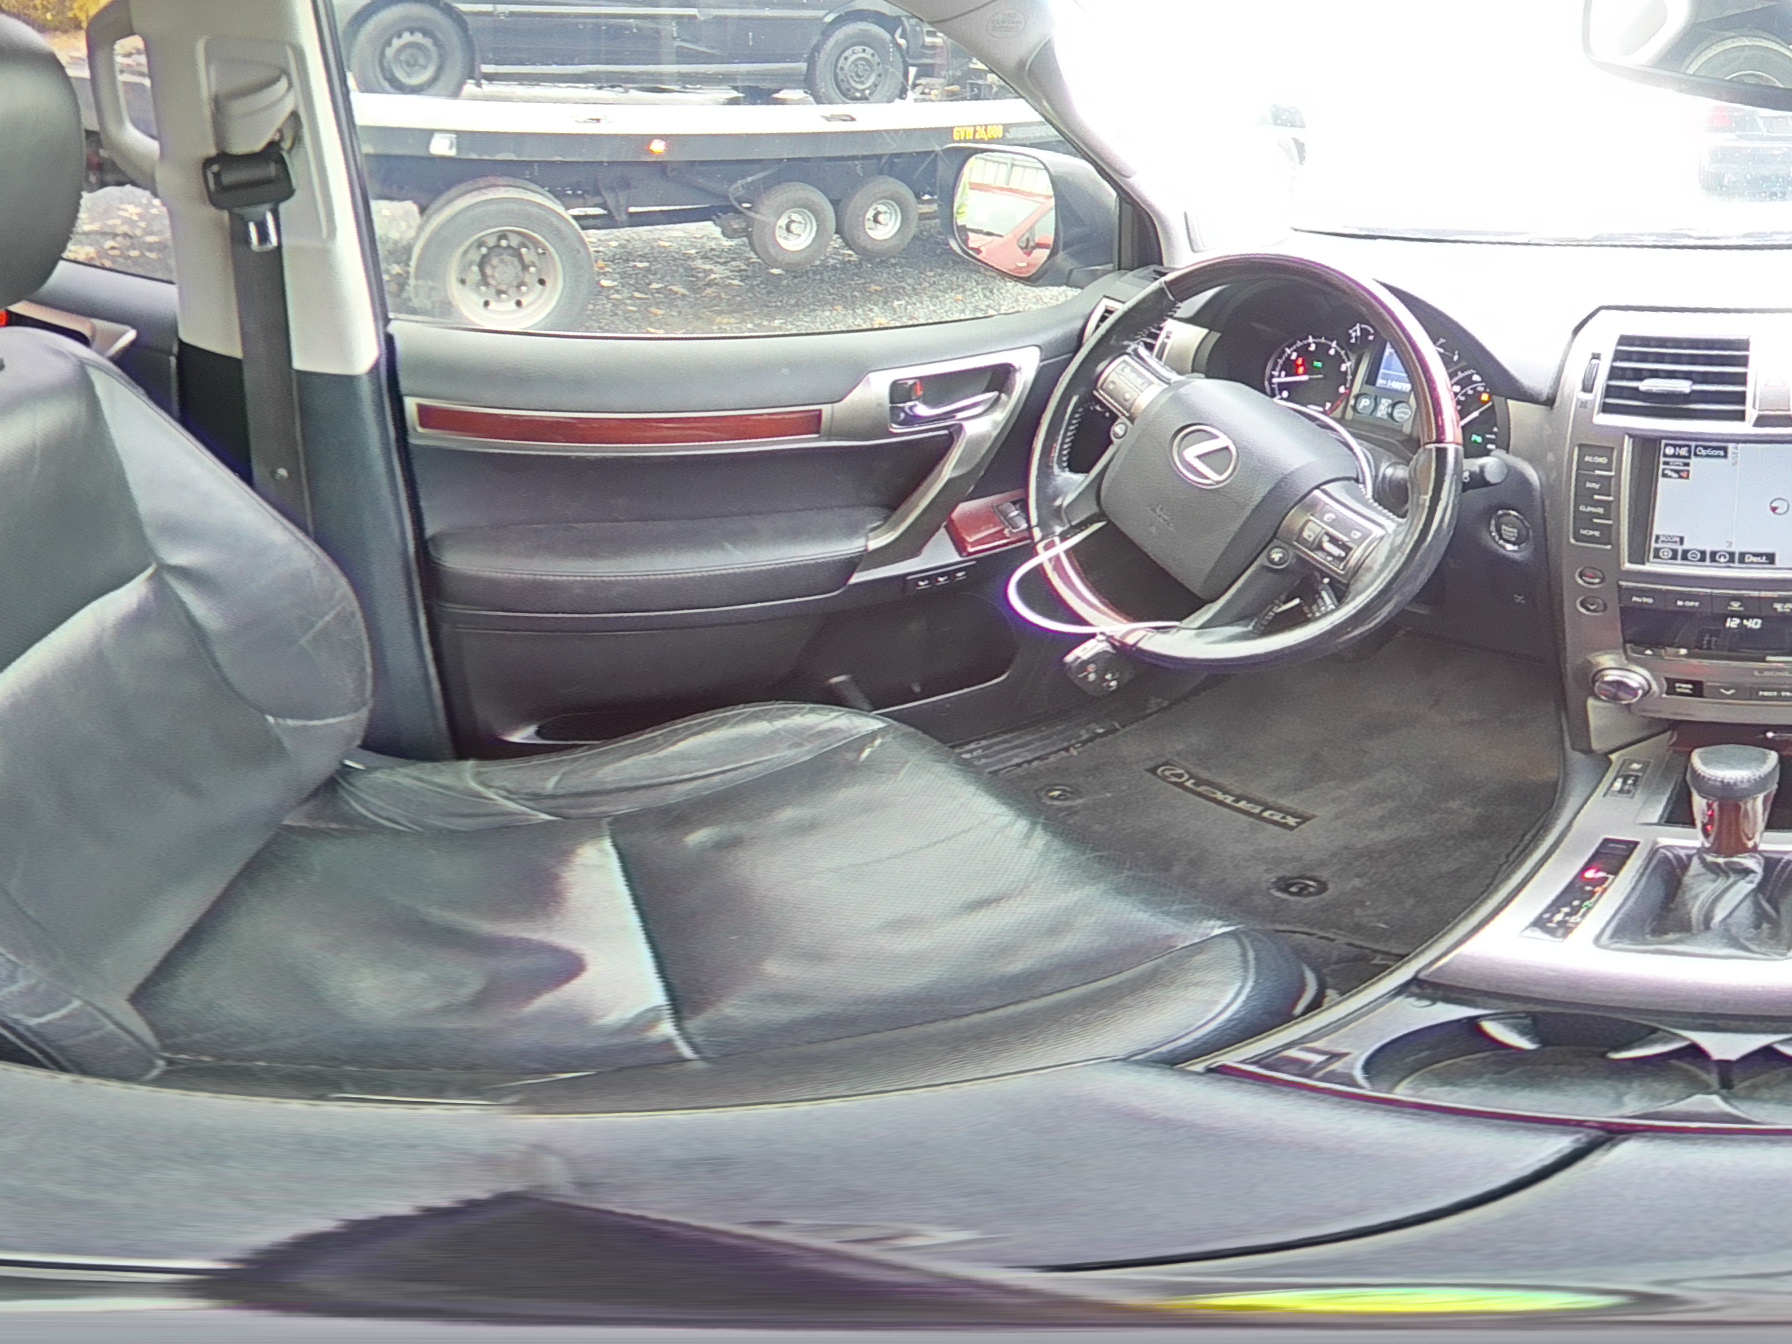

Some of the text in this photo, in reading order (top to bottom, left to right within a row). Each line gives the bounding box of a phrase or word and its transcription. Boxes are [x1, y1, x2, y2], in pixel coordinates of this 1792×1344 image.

[953, 126, 974, 140] GVW
[1695, 446, 1726, 457] Options
[1183, 778, 1265, 814] LEXUS
